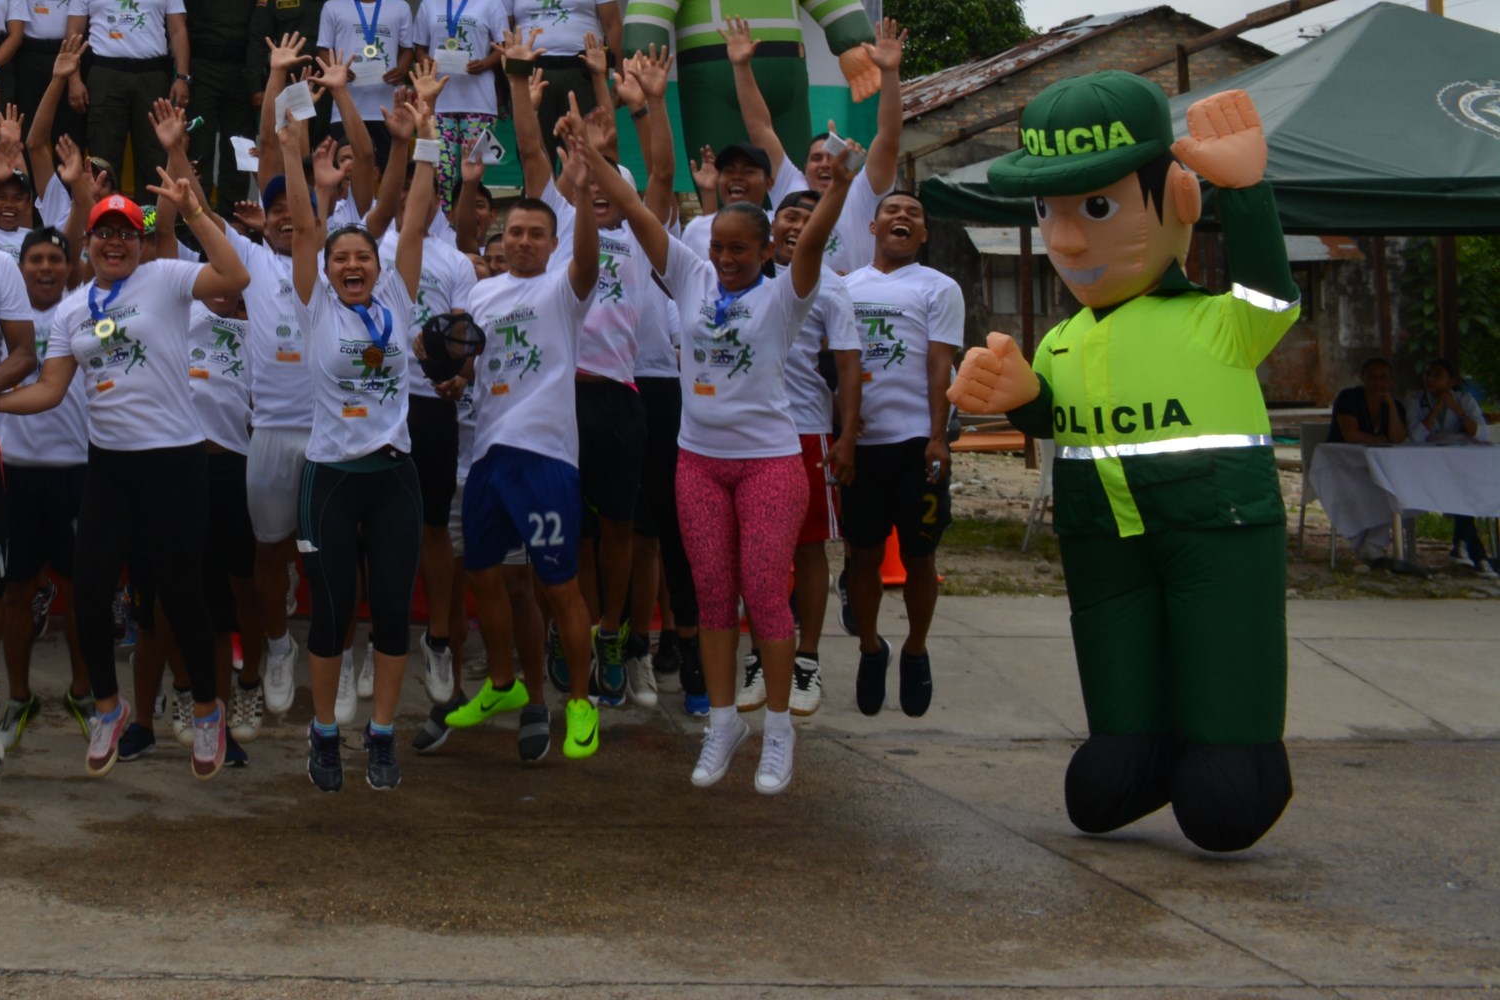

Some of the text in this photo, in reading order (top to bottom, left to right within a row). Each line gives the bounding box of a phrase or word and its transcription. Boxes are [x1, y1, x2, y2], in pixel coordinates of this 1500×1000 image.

[495, 325, 529, 347] 7k
[861, 318, 895, 341] 7k
[1054, 398, 1192, 434] OLICIA
[922, 494, 938, 524] 2
[528, 511, 565, 548] 22
